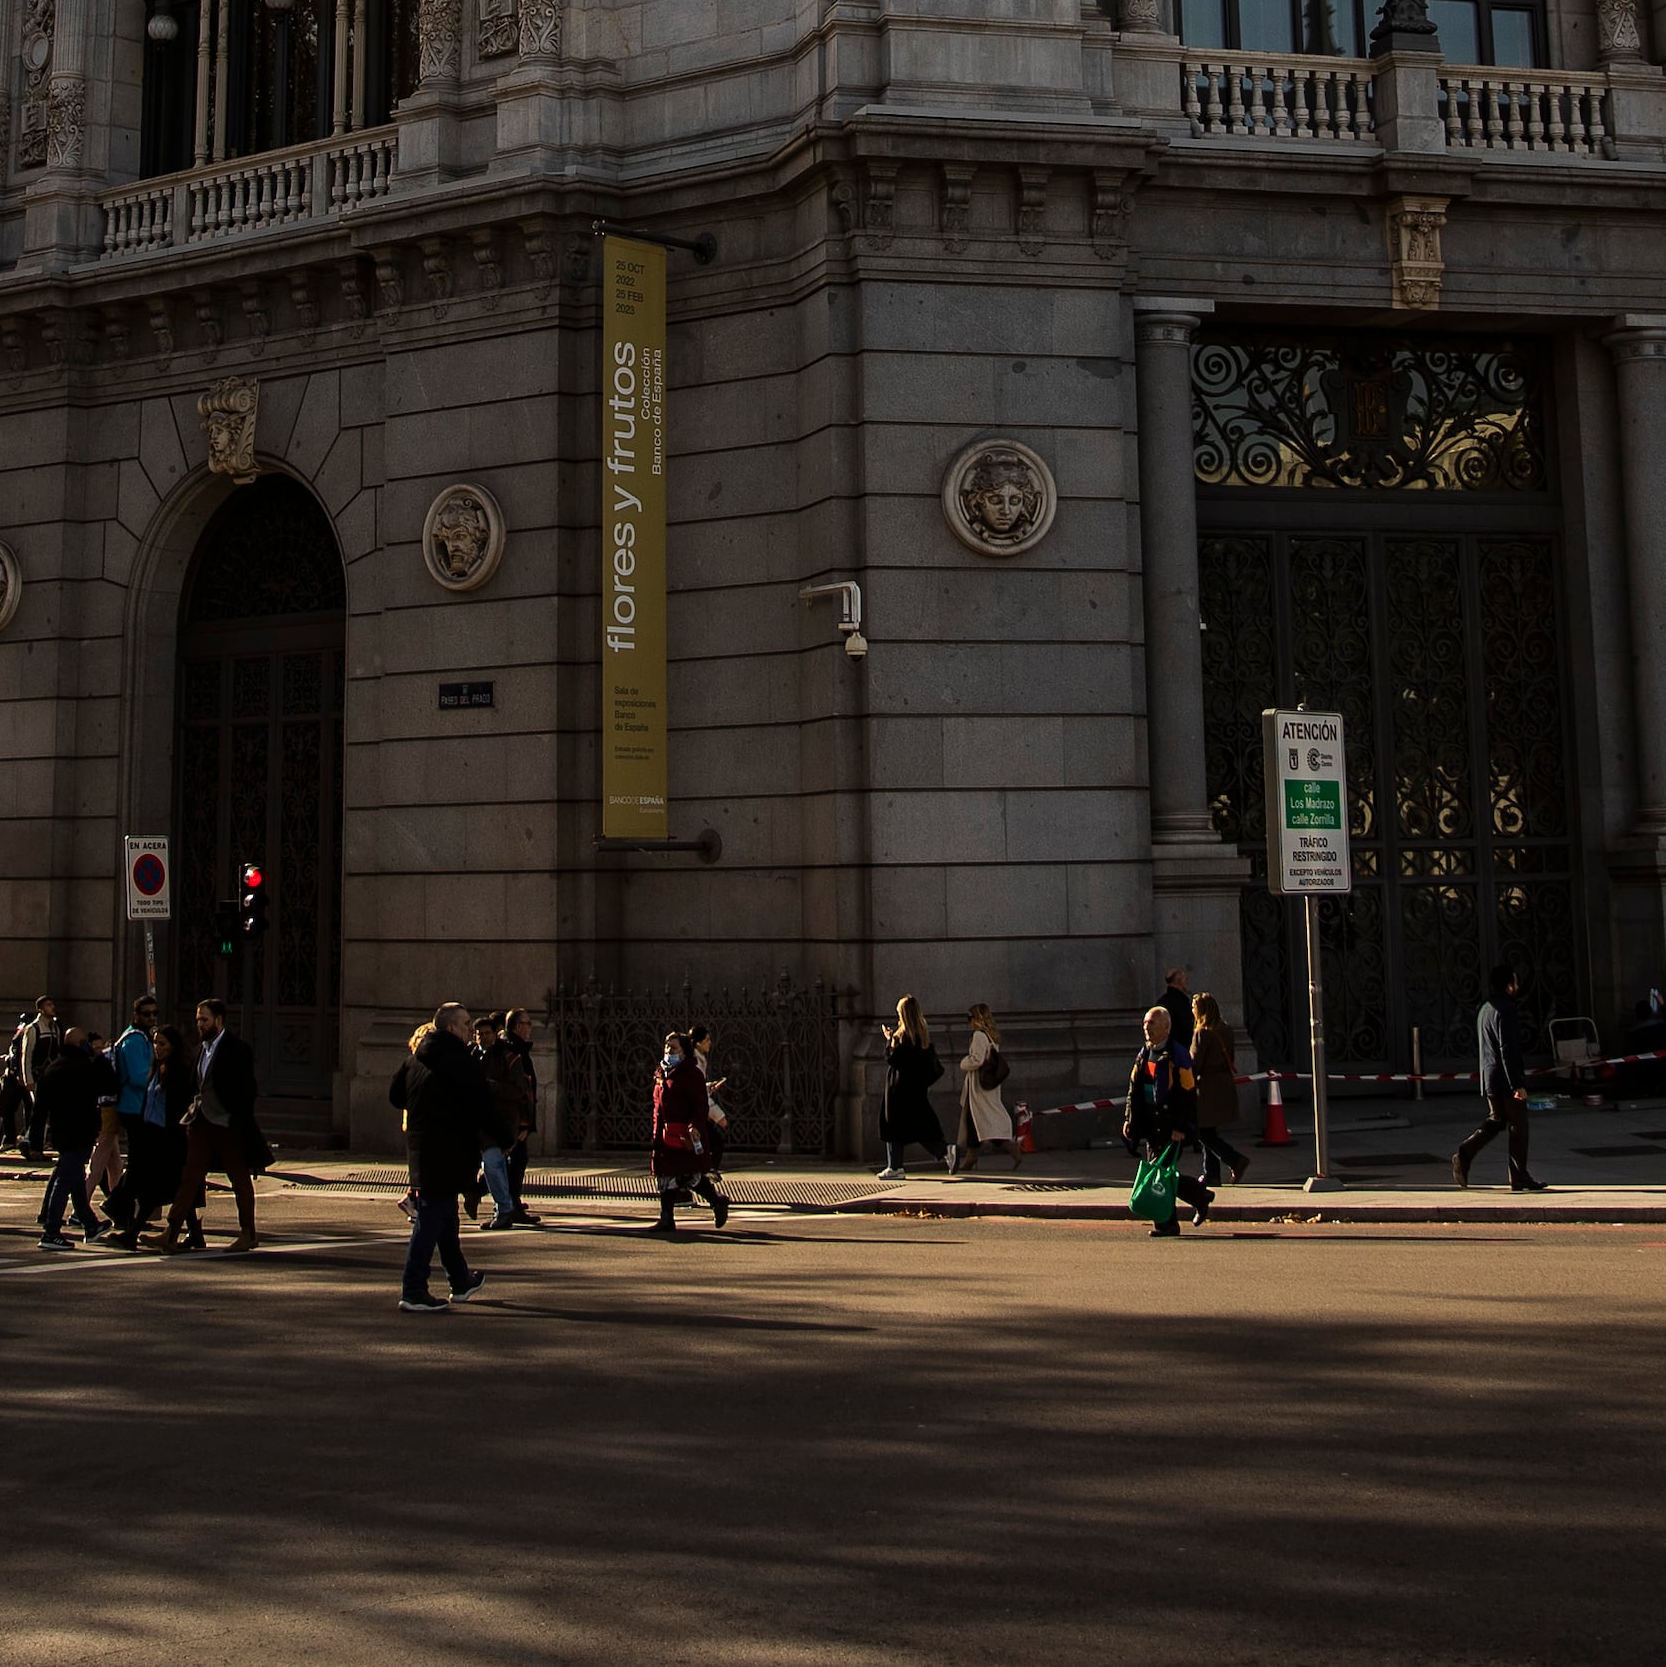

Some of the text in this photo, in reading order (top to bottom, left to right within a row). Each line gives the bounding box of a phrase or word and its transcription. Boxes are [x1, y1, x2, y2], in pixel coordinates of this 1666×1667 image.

[616, 260, 645, 275] 25 OCT
[616, 274, 635, 287] 2022
[627, 290, 644, 302] FEB
[615, 303, 635, 315] 2023
[641, 347, 651, 420] Colección
[652, 348, 663, 475] Banco de España
[606, 341, 643, 653] flores y frutos
[614, 686, 639, 696] Sala de
[614, 699, 656, 709] exposiciones
[614, 710, 636, 720] Banco
[614, 722, 649, 732] de España
[1282, 719, 1337, 741] ATENCIÓN
[1303, 782, 1321, 794] calle
[1290, 796, 1335, 810] Los Madrazo
[1292, 813, 1335, 825] calle Zorrilla
[130, 842, 166, 850] EN ACERA
[1299, 835, 1328, 848] TRÁFICO
[1293, 851, 1337, 862] RESTRINGIDO
[1290, 868, 1313, 876] EXCEPTO
[1299, 878, 1334, 886] AUTORIZADOS
